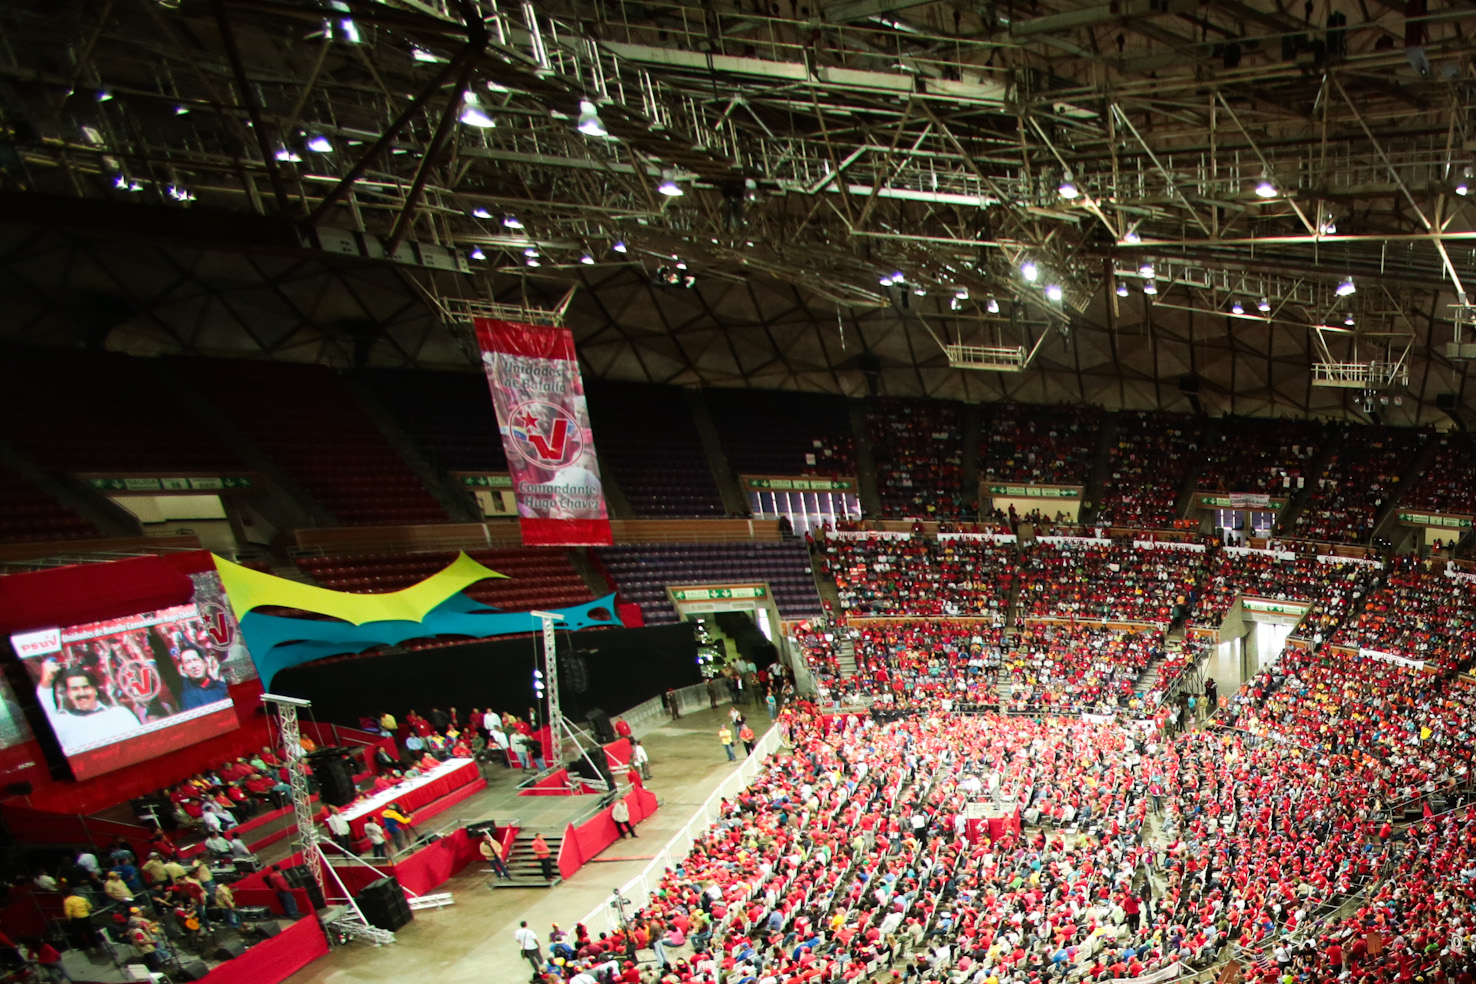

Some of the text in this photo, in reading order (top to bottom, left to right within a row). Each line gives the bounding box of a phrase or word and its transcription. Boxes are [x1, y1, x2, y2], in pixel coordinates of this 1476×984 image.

[518, 480, 597, 496] Comandante
[525, 496, 557, 511] Hugo
[62, 630, 93, 643] Unidades
[94, 629, 104, 638] de
